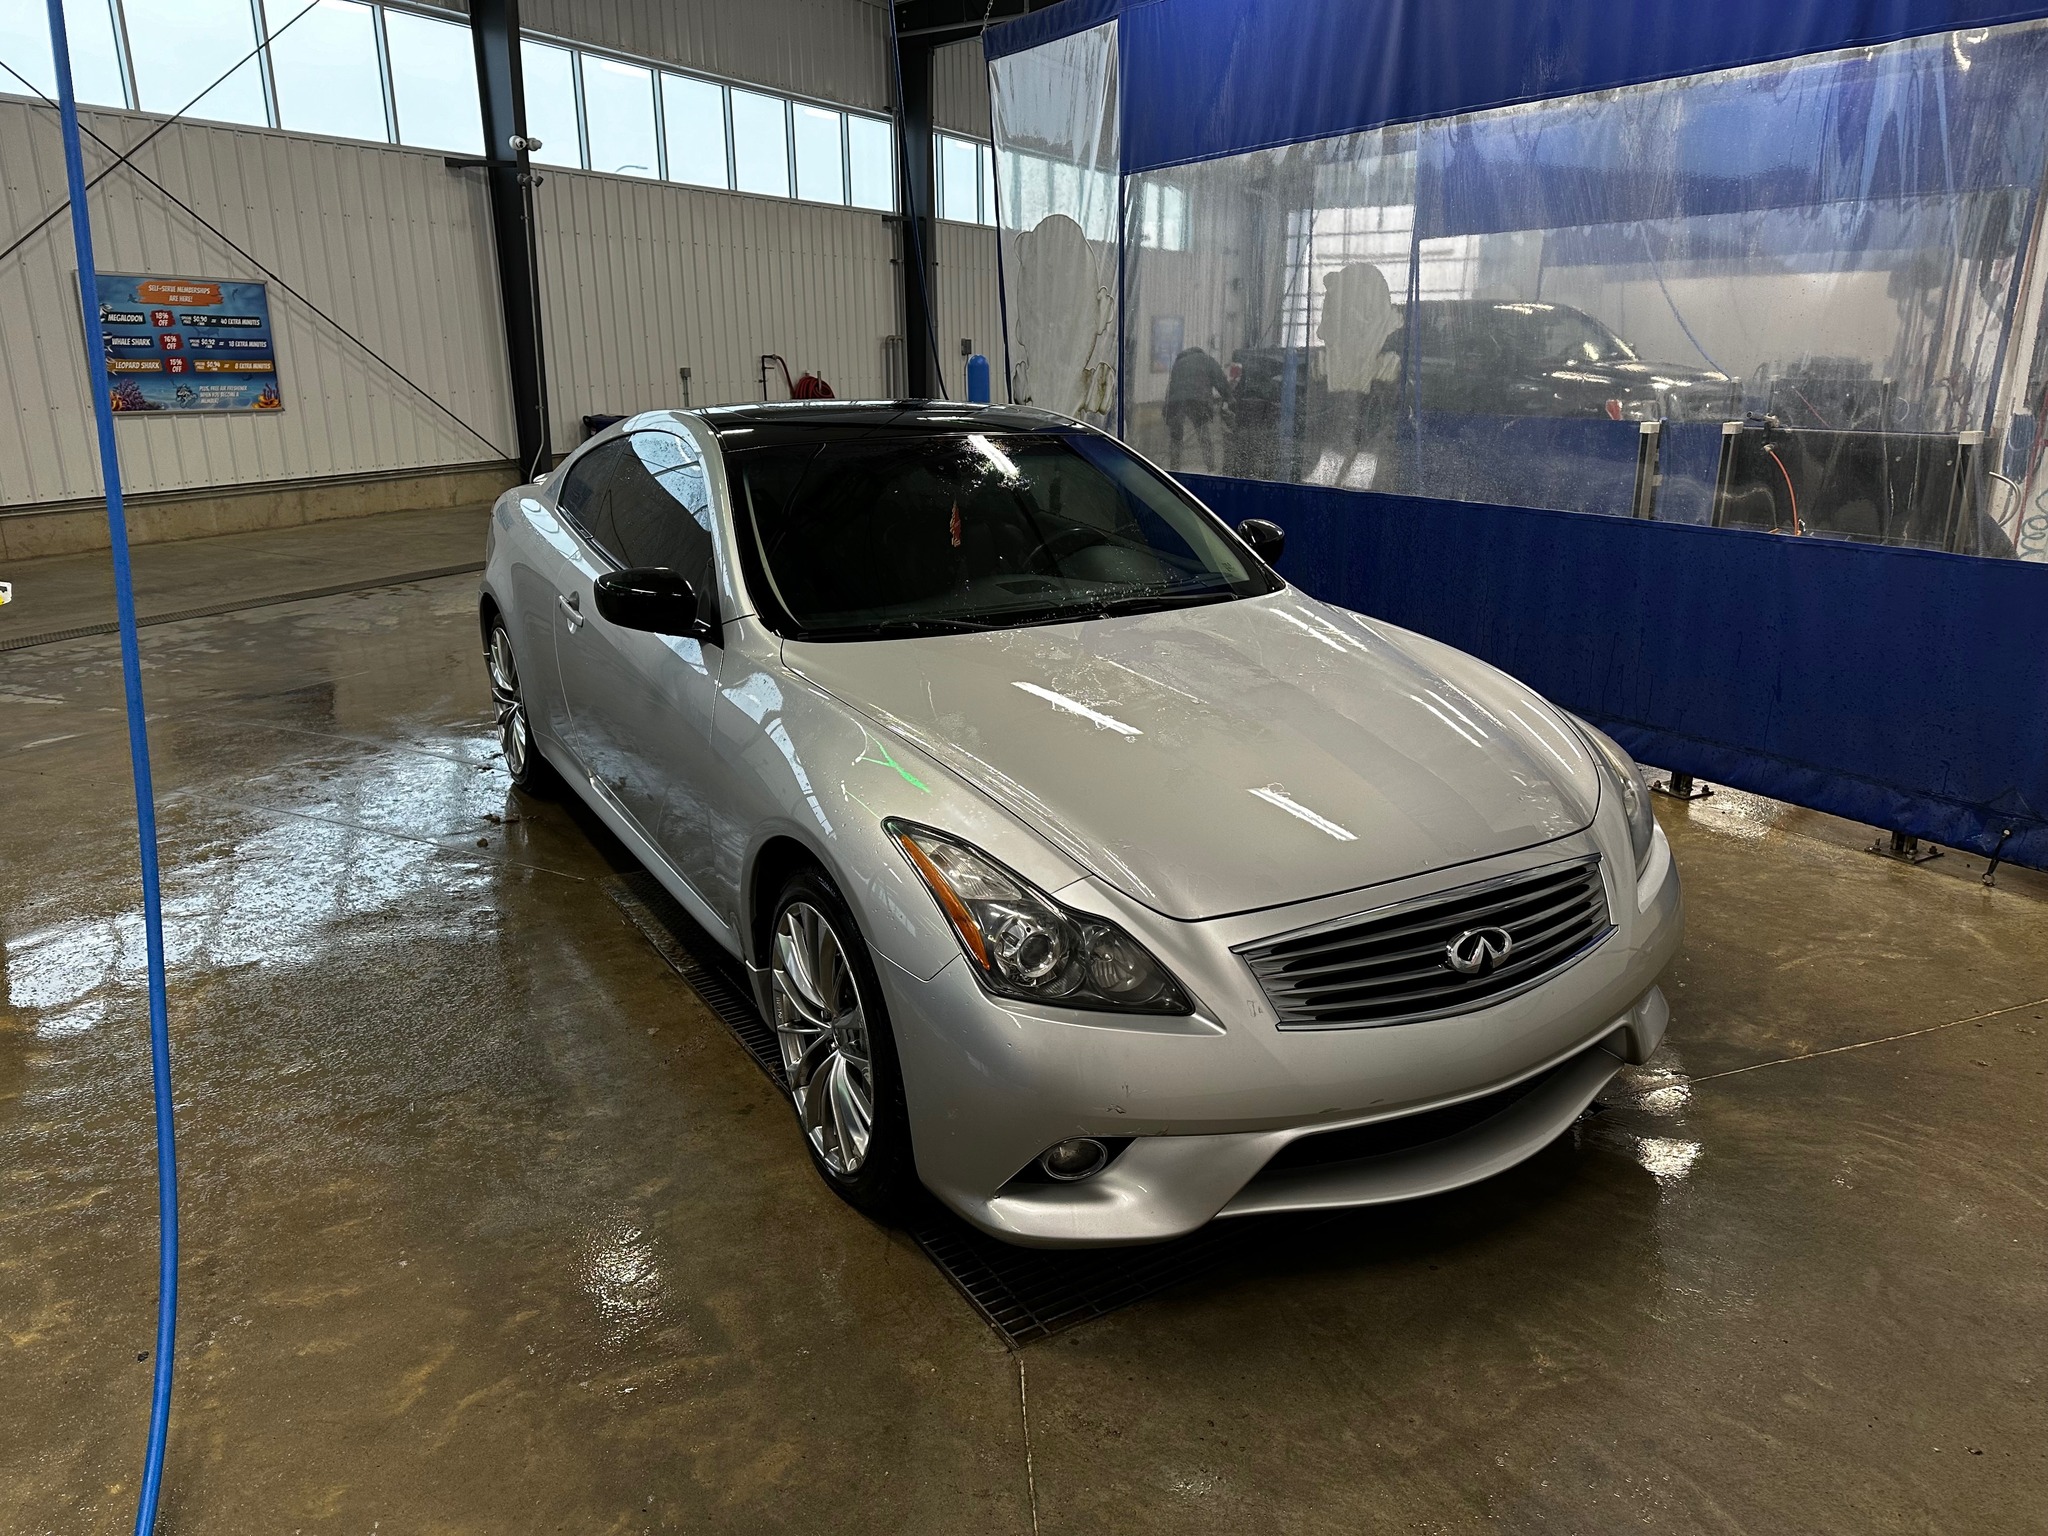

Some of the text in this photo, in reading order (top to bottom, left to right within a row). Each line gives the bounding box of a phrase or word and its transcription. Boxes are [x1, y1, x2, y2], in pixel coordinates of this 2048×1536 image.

[148, 284, 211, 295] SELF-SERVE MEMBERSHIPS
[107, 313, 144, 323] MEGALODON
[158, 319, 169, 327] OFF
[111, 337, 151, 346] WHALE SHARK
[166, 342, 177, 350] OFF
[115, 361, 160, 369] LEOPARD SHARK
[171, 365, 182, 373] OFF
